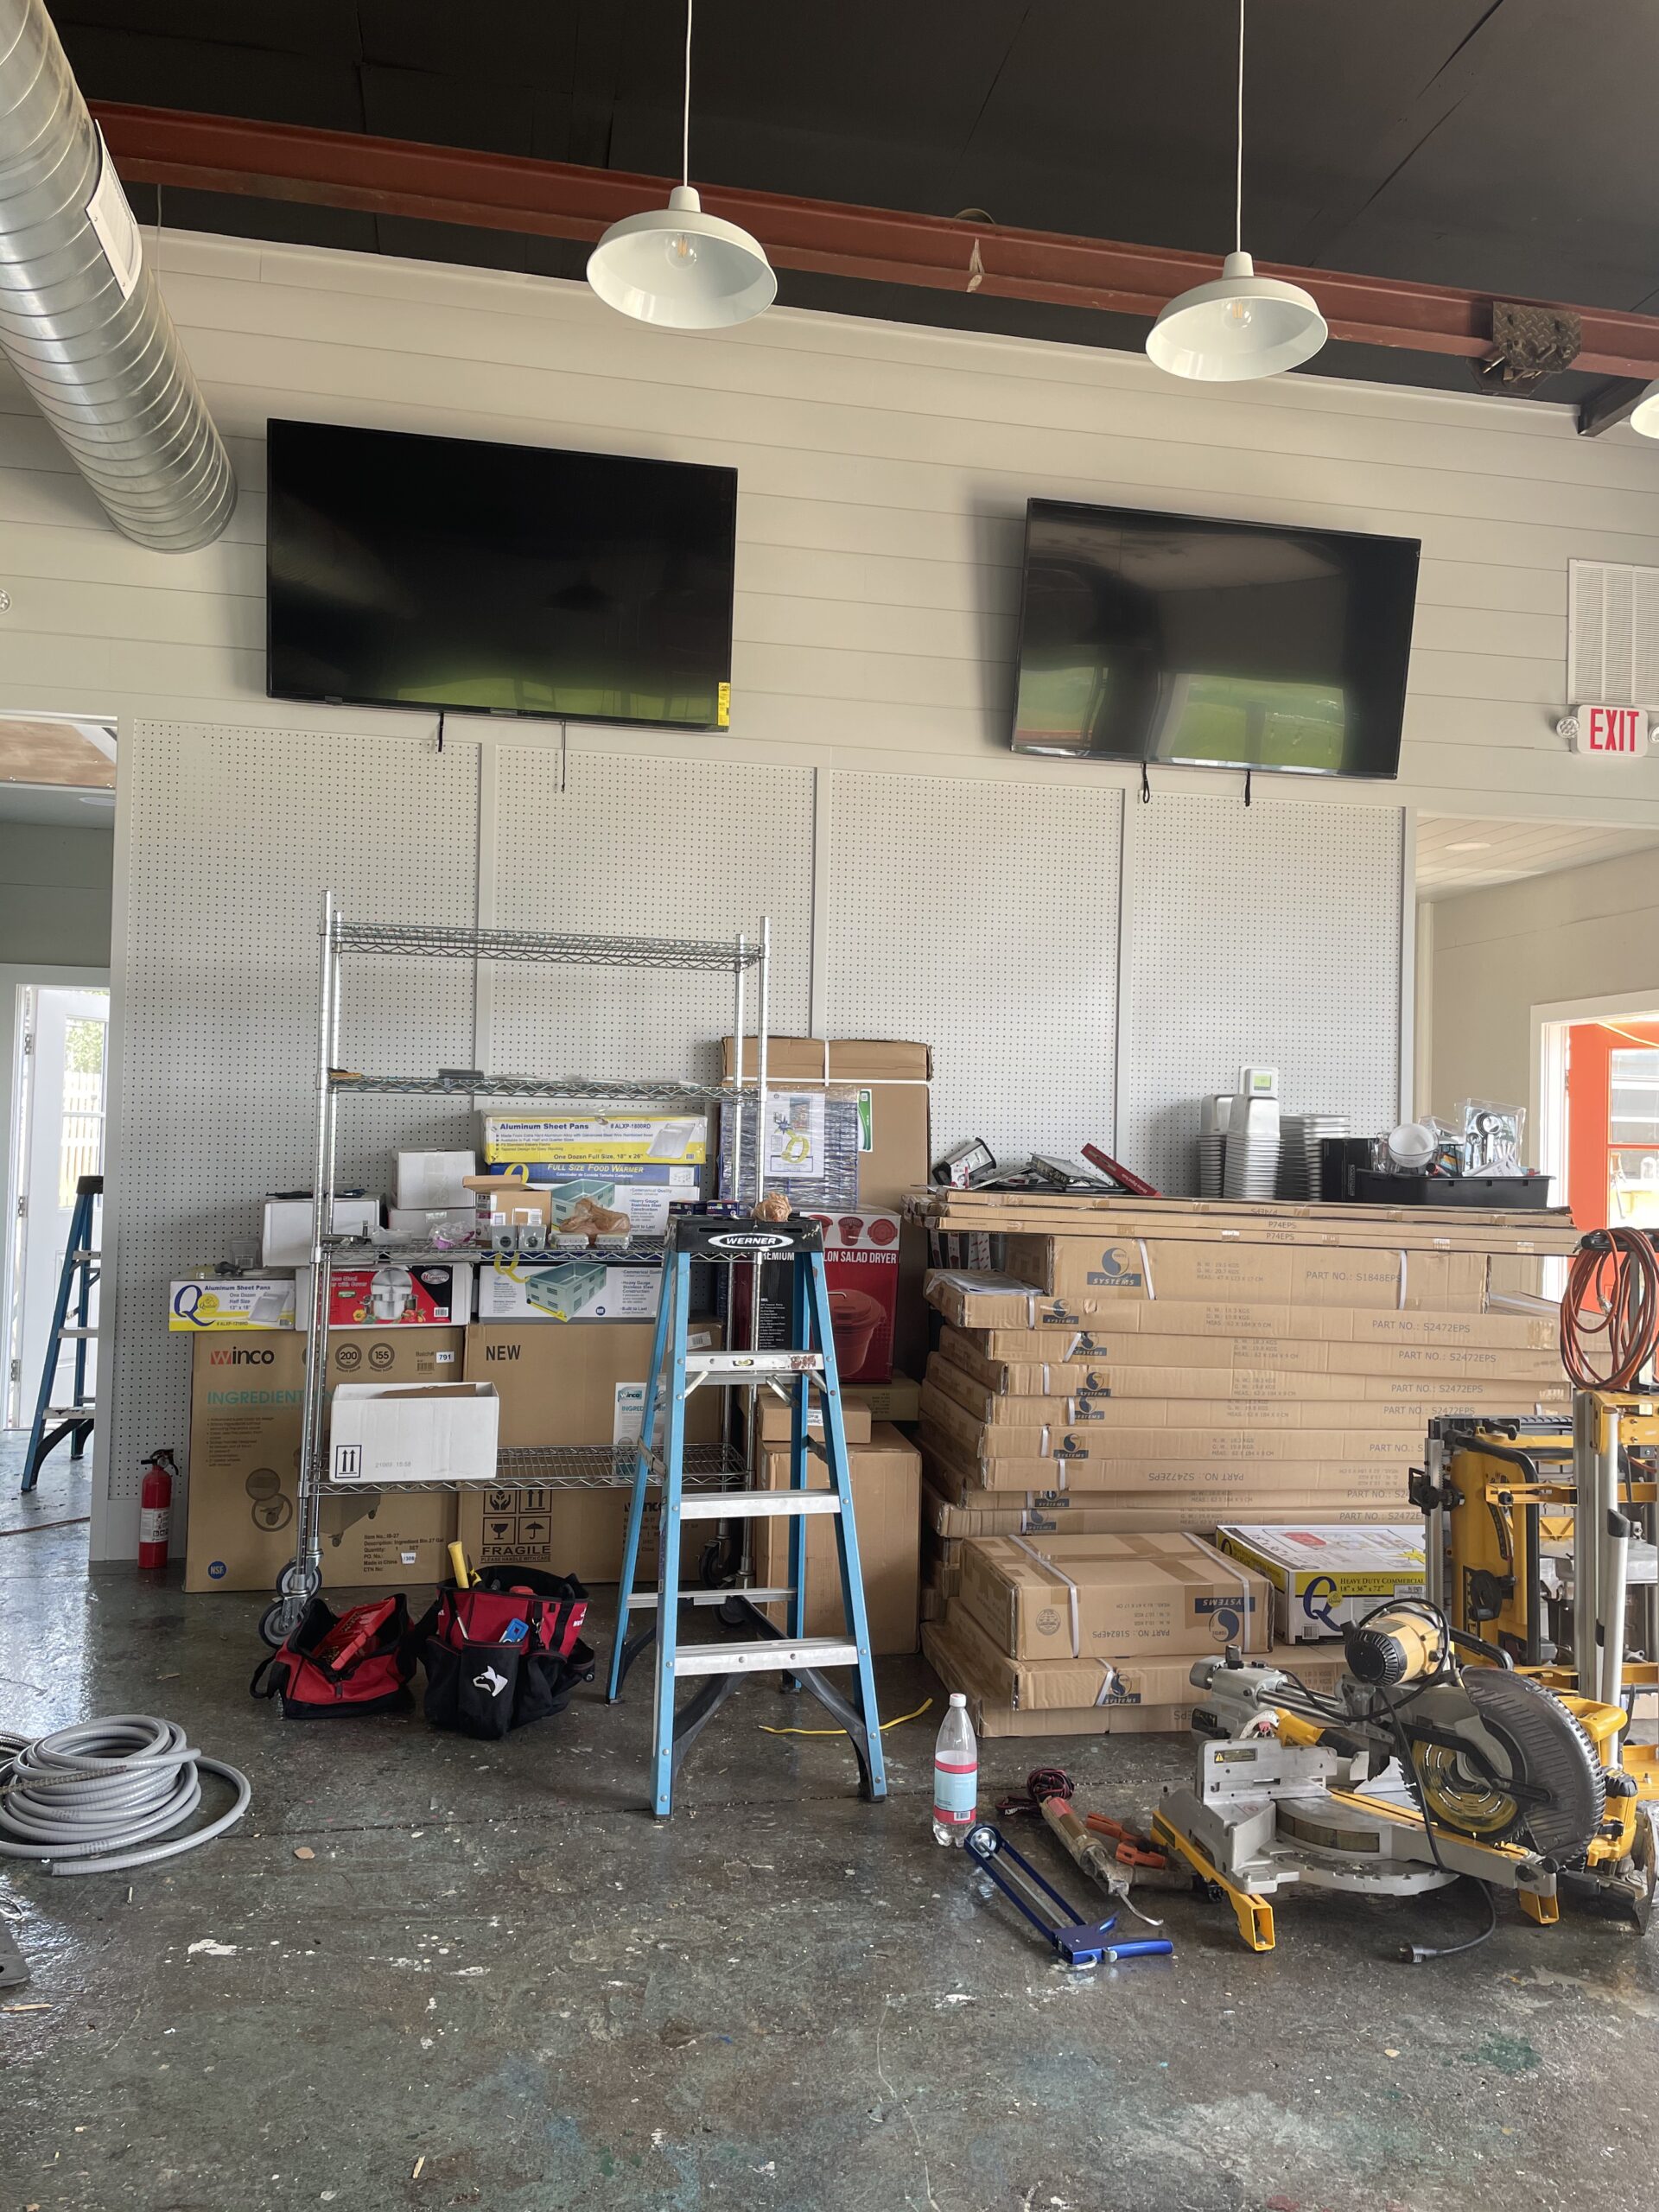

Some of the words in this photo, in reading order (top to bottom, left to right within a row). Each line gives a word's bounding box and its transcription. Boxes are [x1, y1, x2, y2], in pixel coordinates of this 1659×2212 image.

[1590, 709, 1639, 752] EXIT
[1268, 1220, 1296, 1229] P74EPS
[725, 1236, 777, 1245] WERNER
[1266, 1232, 1294, 1241] P74EPS
[840, 1254, 868, 1263] SALAD
[870, 1254, 897, 1264] DRYER
[1306, 1271, 1328, 1281] PART
[1332, 1272, 1352, 1281] NO.:
[1356, 1272, 1402, 1282] S1848EPS
[1092, 1277, 1135, 1286] SYSTEMS
[1372, 1320, 1395, 1329] PART
[1399, 1322, 1420, 1331] NO.:
[1423, 1322, 1471, 1333] S2472EPS
[340, 1351, 358, 1360] 200
[486, 1344, 521, 1361] NEW
[1399, 1351, 1422, 1359] PART
[1426, 1352, 1446, 1361] NO.:
[1449, 1353, 1497, 1362] S2472EPS
[1416, 1384, 1435, 1393] NO.:
[1383, 1406, 1406, 1414] PART
[1432, 1407, 1476, 1415] S2472EPS
[1148, 1472, 1194, 1481] S2472EPS
[1347, 1490, 1369, 1498] PART
[482, 1545, 551, 1555] FRAGILE
